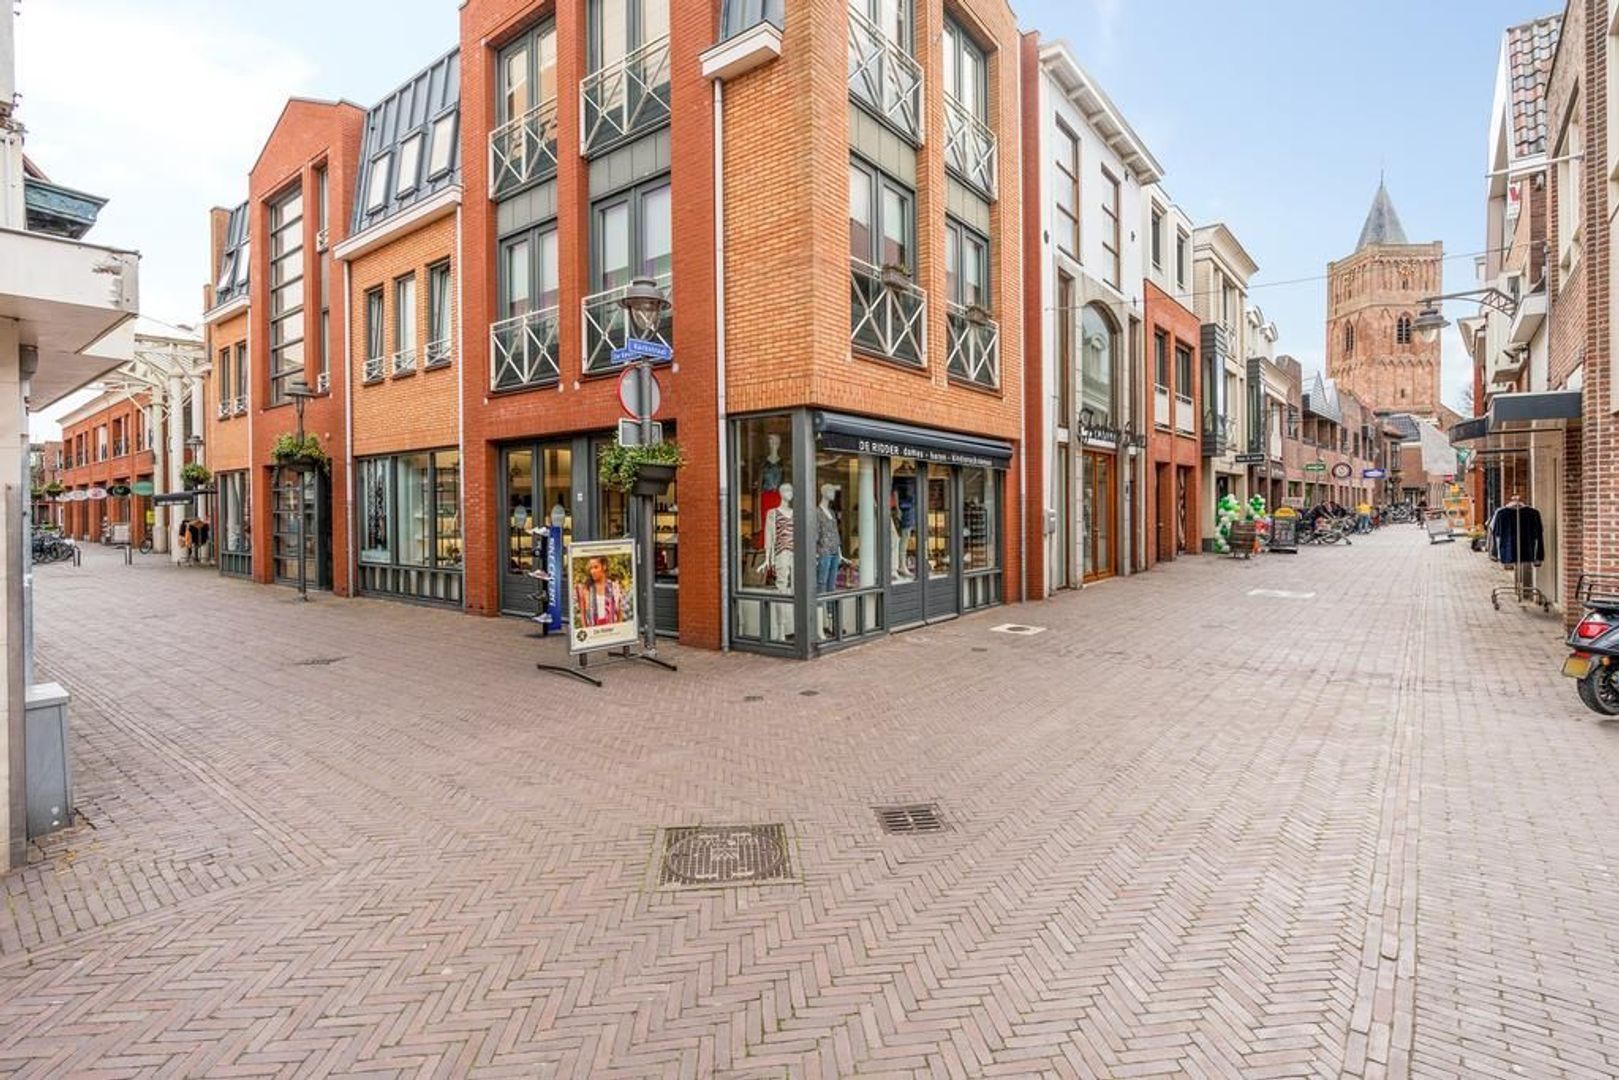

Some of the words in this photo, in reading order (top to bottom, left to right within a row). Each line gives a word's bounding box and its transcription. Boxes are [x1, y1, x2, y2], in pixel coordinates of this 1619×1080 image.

[859, 441, 870, 451] DE
[872, 442, 899, 456] RIDDER
[903, 447, 924, 459] dames
